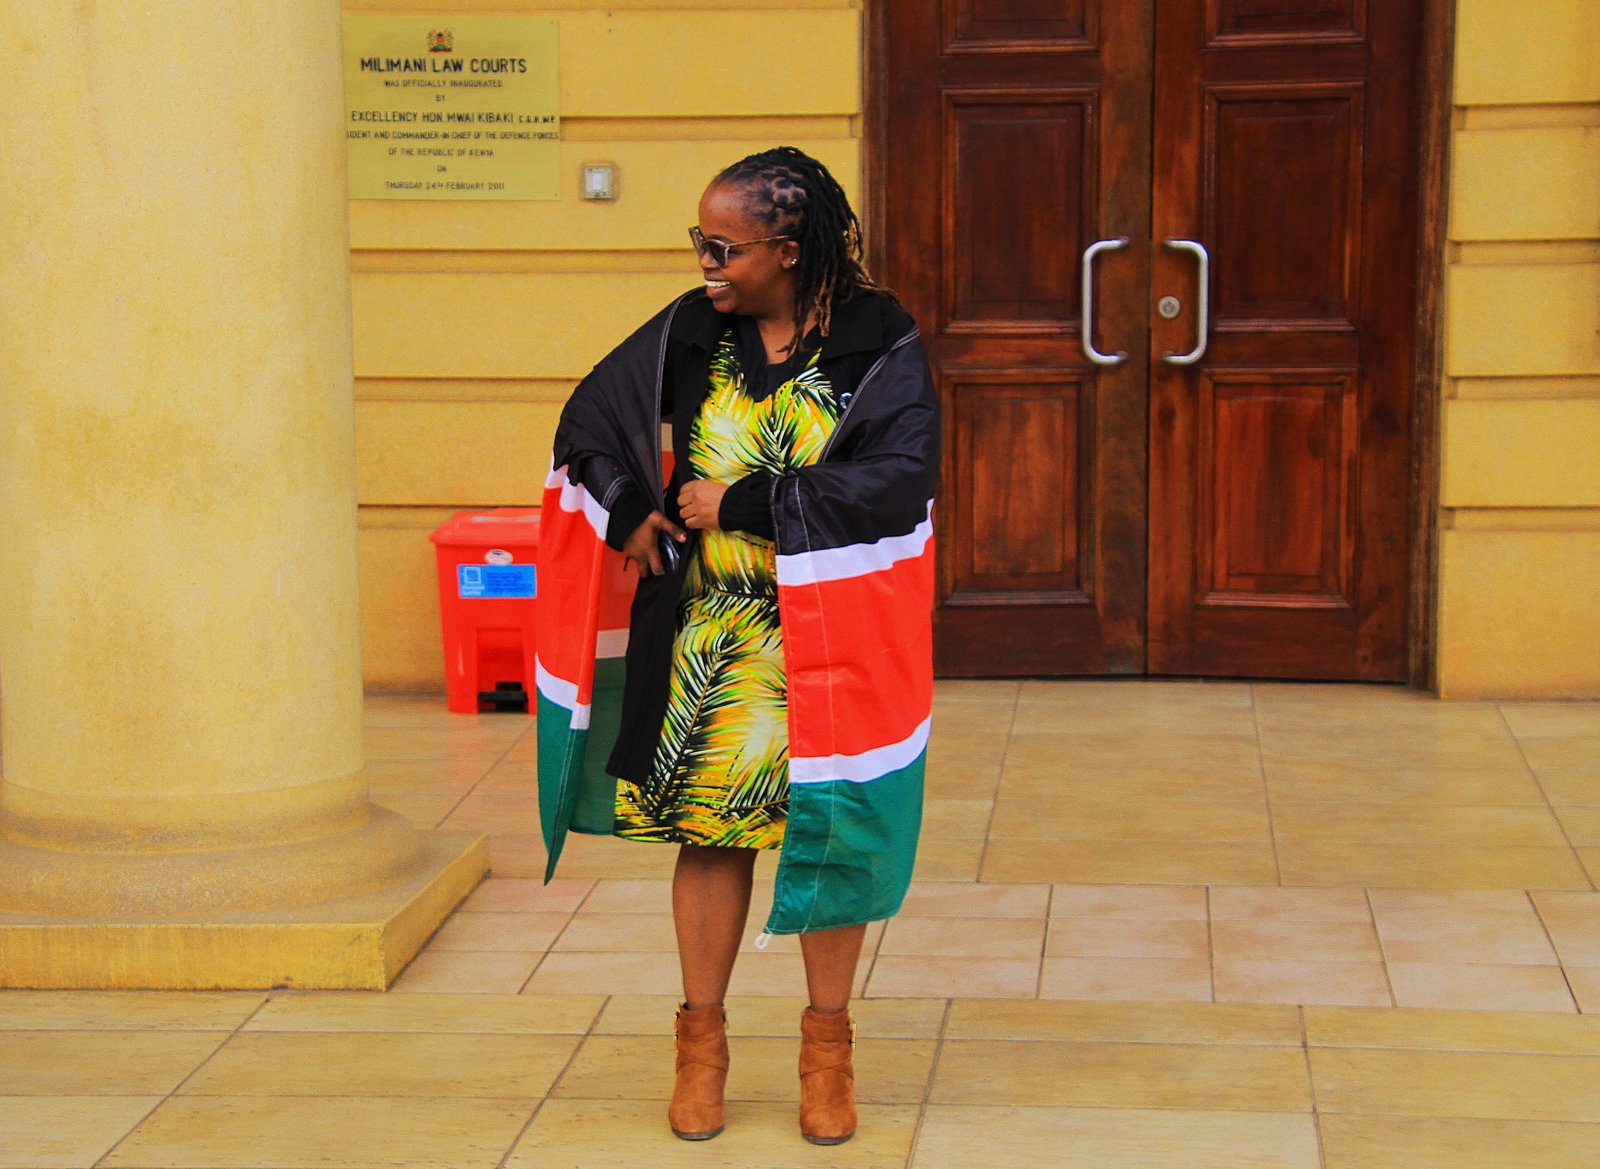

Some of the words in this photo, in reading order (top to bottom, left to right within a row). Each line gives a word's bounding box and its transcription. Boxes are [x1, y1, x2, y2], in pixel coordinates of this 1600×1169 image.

[361, 57, 427, 73] MILIMANI
[432, 58, 464, 73] LAW
[470, 58, 527, 73] COURTS
[384, 79, 400, 87] WAS
[402, 79, 446, 87] OFFICIALLY
[450, 79, 503, 88] INAUGURATED
[351, 110, 418, 122] EXCELLENCY
[447, 112, 475, 123] MWAI
[478, 112, 514, 123] KIBAKI
[374, 131, 390, 139] AND
[486, 132, 497, 140] THE
[388, 147, 398, 156] OF
[401, 148, 414, 156] THE
[417, 148, 454, 157] REPUBLIC
[457, 149, 466, 157] OF
[469, 149, 495, 157] KENYA
[385, 181, 423, 190] THURSDAY
[446, 181, 485, 190] FEBRUARY
[488, 182, 505, 190] 2011
